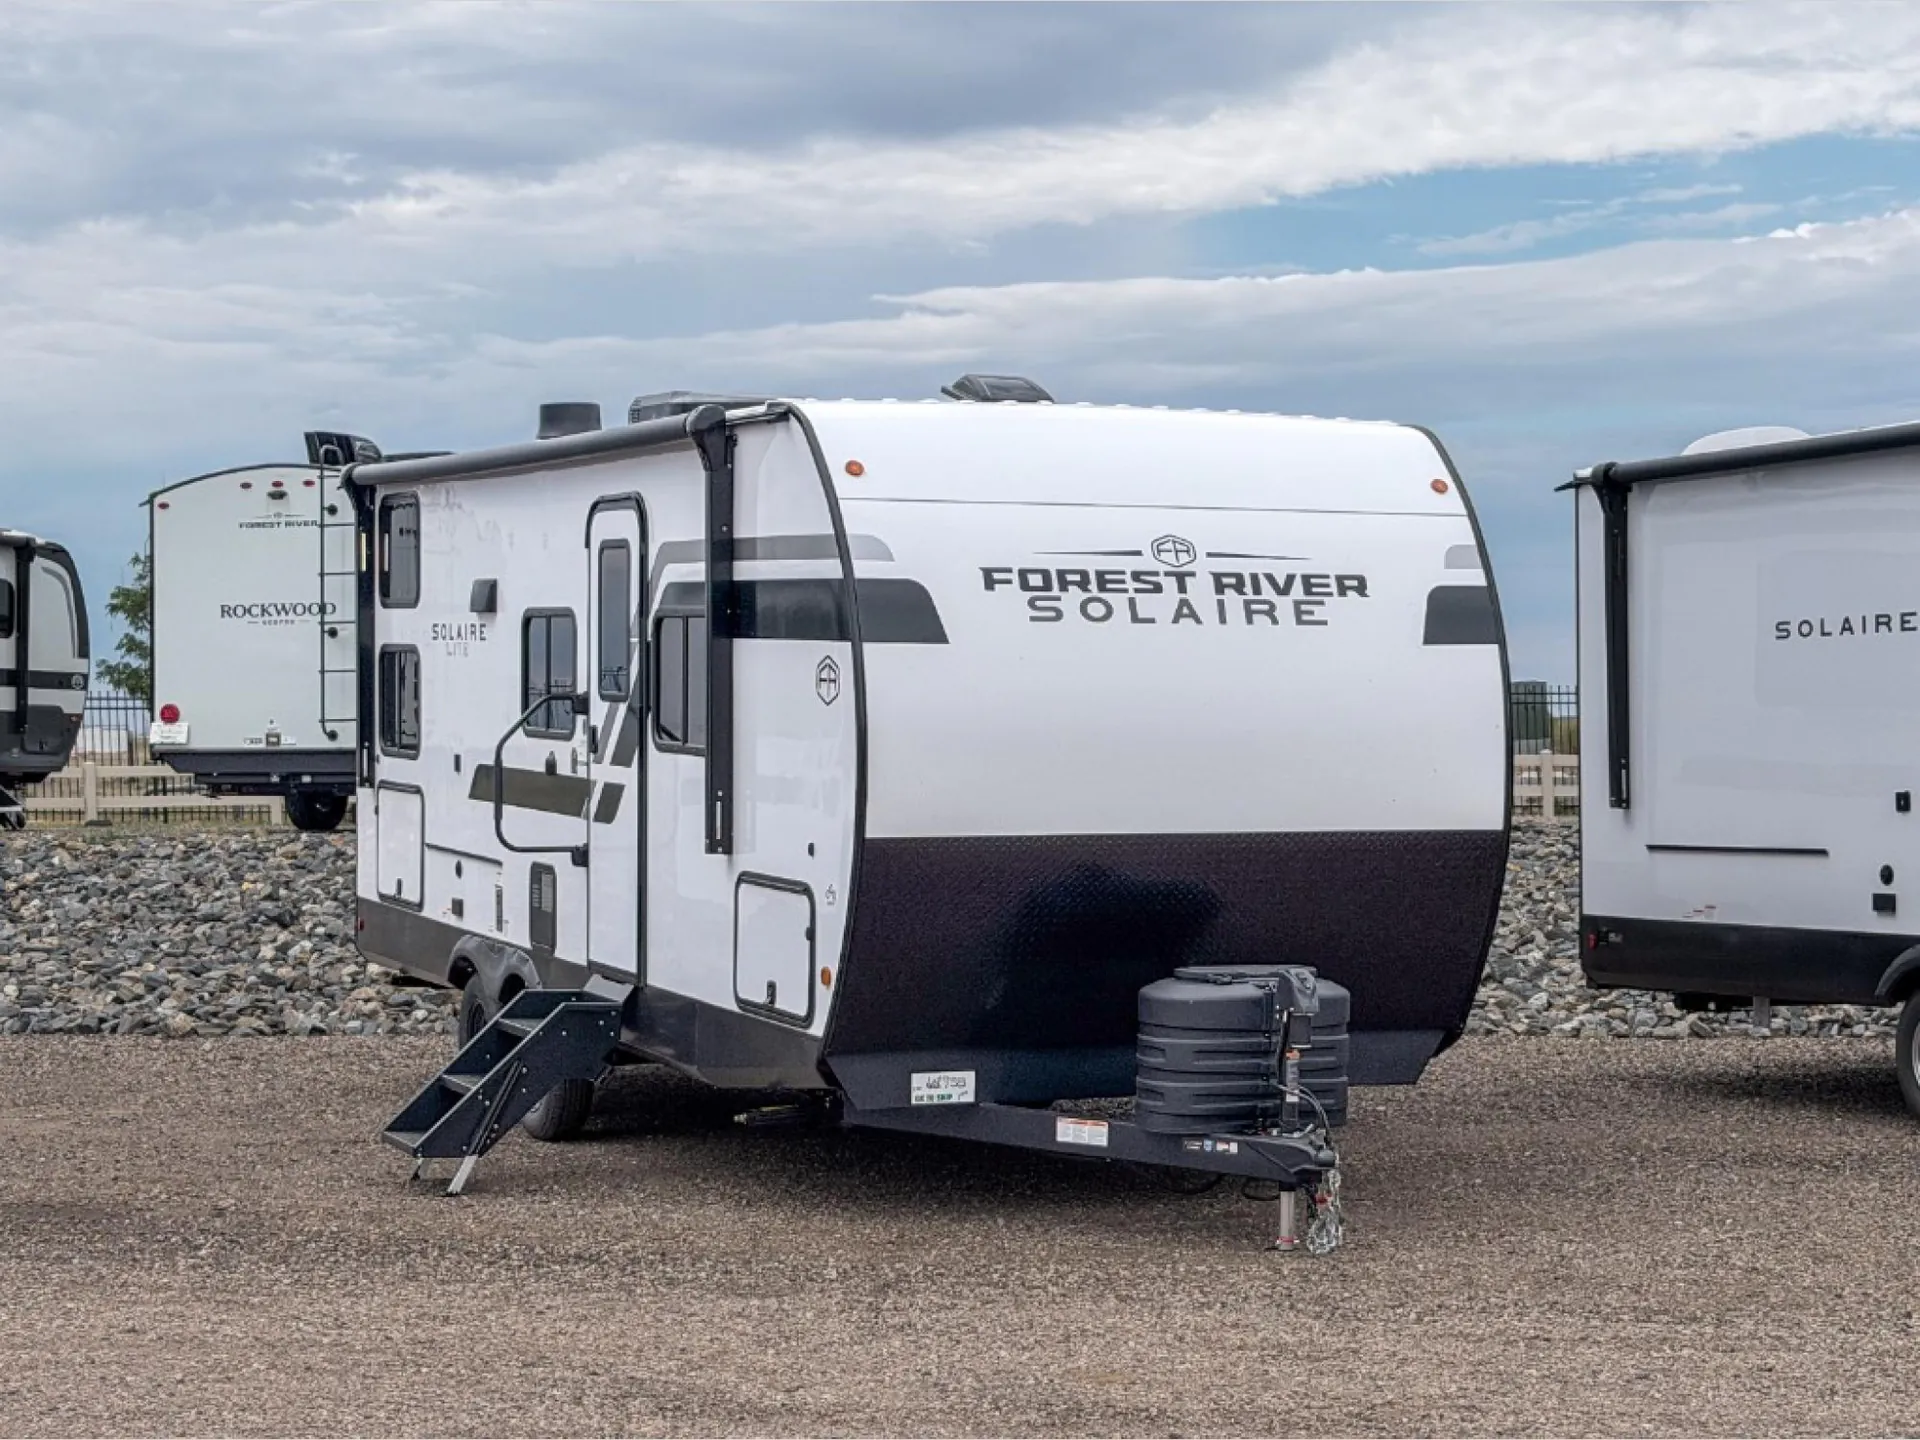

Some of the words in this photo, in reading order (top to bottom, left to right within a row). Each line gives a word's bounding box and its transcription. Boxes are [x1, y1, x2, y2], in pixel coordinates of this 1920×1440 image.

[978, 566, 1198, 594] FOREST
[1207, 570, 1371, 598] RIVER
[220, 602, 337, 619] ROCKWOOD
[1026, 594, 1329, 627] SOLAIRE
[431, 622, 487, 641] SOLAIRE
[1774, 611, 1918, 641] SOLAIRE
[446, 641, 469, 658] LITE
